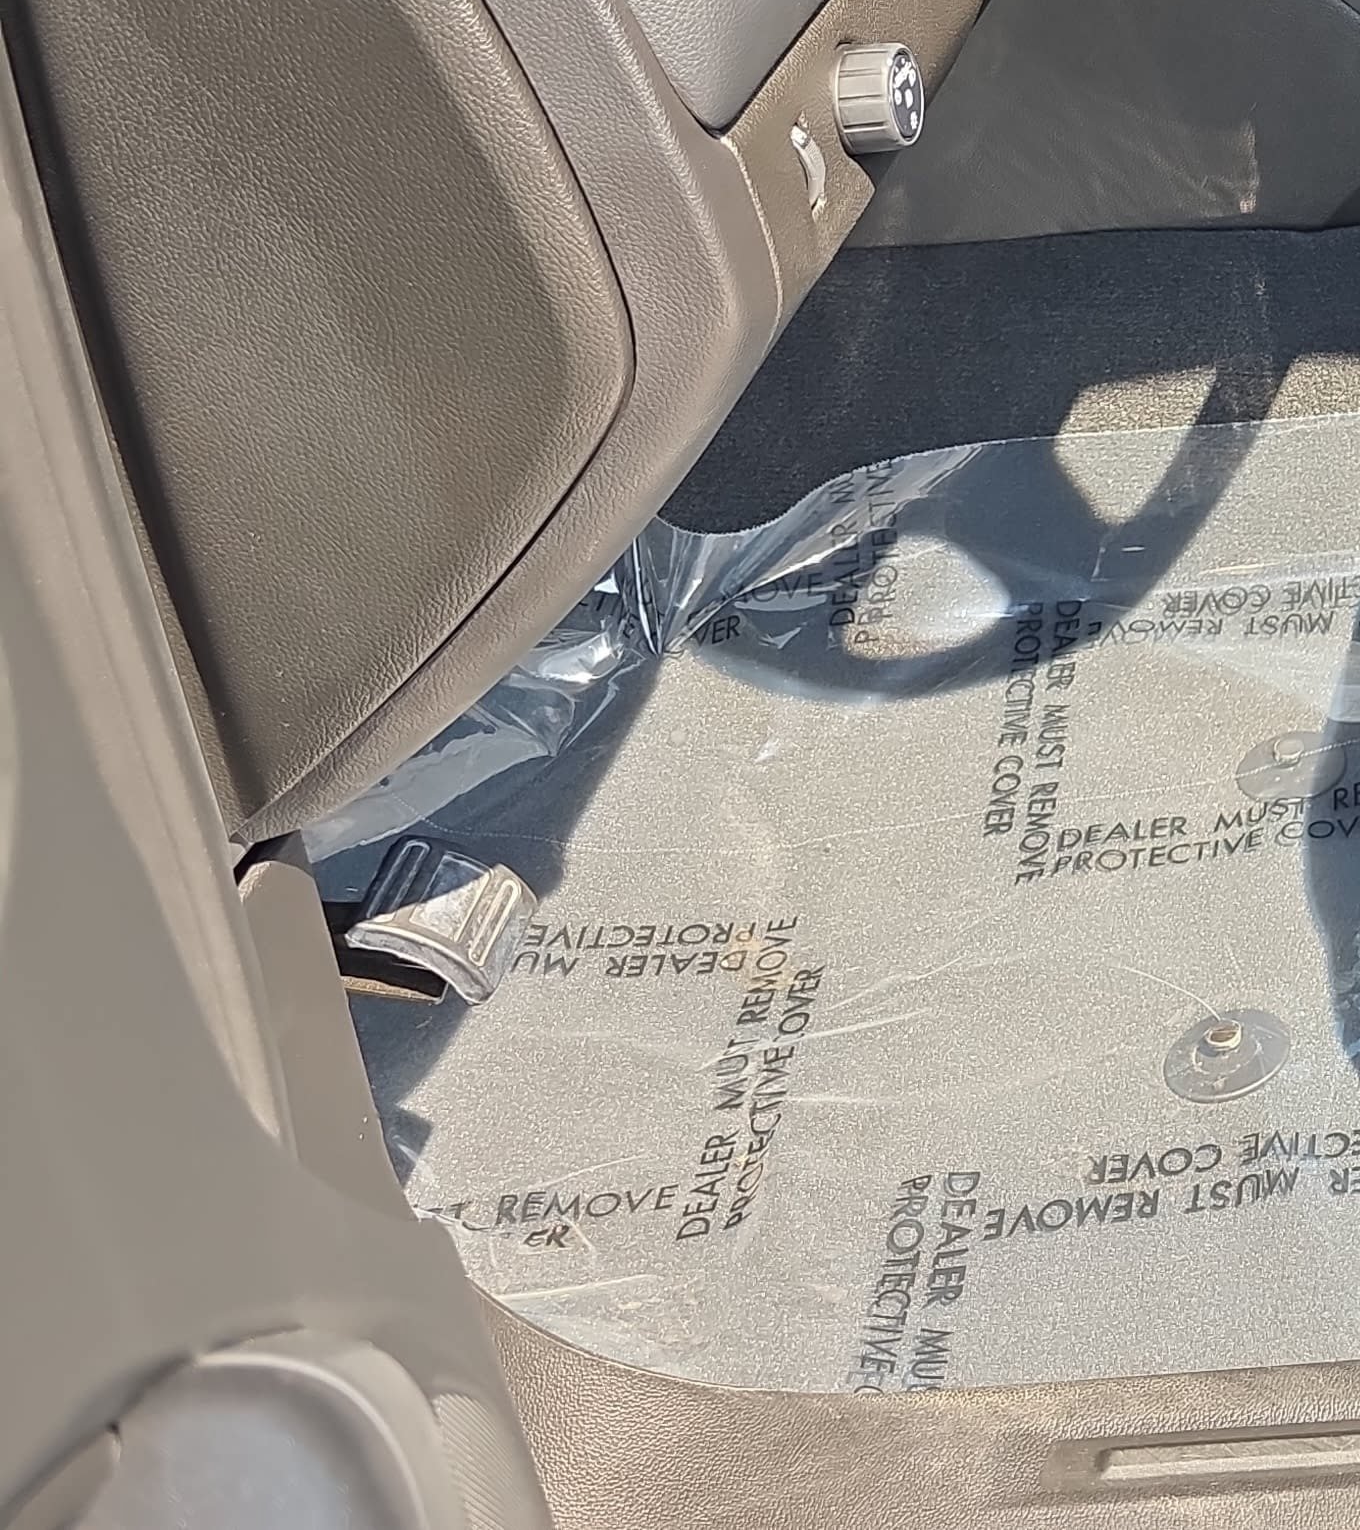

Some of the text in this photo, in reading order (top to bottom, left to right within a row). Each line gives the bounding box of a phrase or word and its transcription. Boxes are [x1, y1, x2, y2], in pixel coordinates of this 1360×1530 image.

[1161, 584, 1271, 618] COVER
[1245, 610, 1333, 637] MUST
[983, 602, 1043, 837] PROTECTIVE COVER
[1014, 600, 1082, 886] DEALER MUST REMOVE
[1056, 816, 1188, 853] DEALER
[1213, 796, 1305, 833] MUST
[1051, 826, 1264, 876] PROTECTIVE
[523, 921, 757, 950] PROTECTIVE
[606, 950, 748, 978] DEALER
[675, 915, 799, 1241] DEALER REMOVE
[722, 964, 826, 1231] PROTECTIVE OVER
[1085, 1141, 1224, 1187] COVER
[1185, 1166, 1299, 1213] MUST
[495, 1183, 680, 1226] REMOVE
[983, 1187, 1159, 1242] REMOVE
[921, 1171, 981, 1309] DEALER
[857, 1174, 933, 1382] PROTECTIVE
